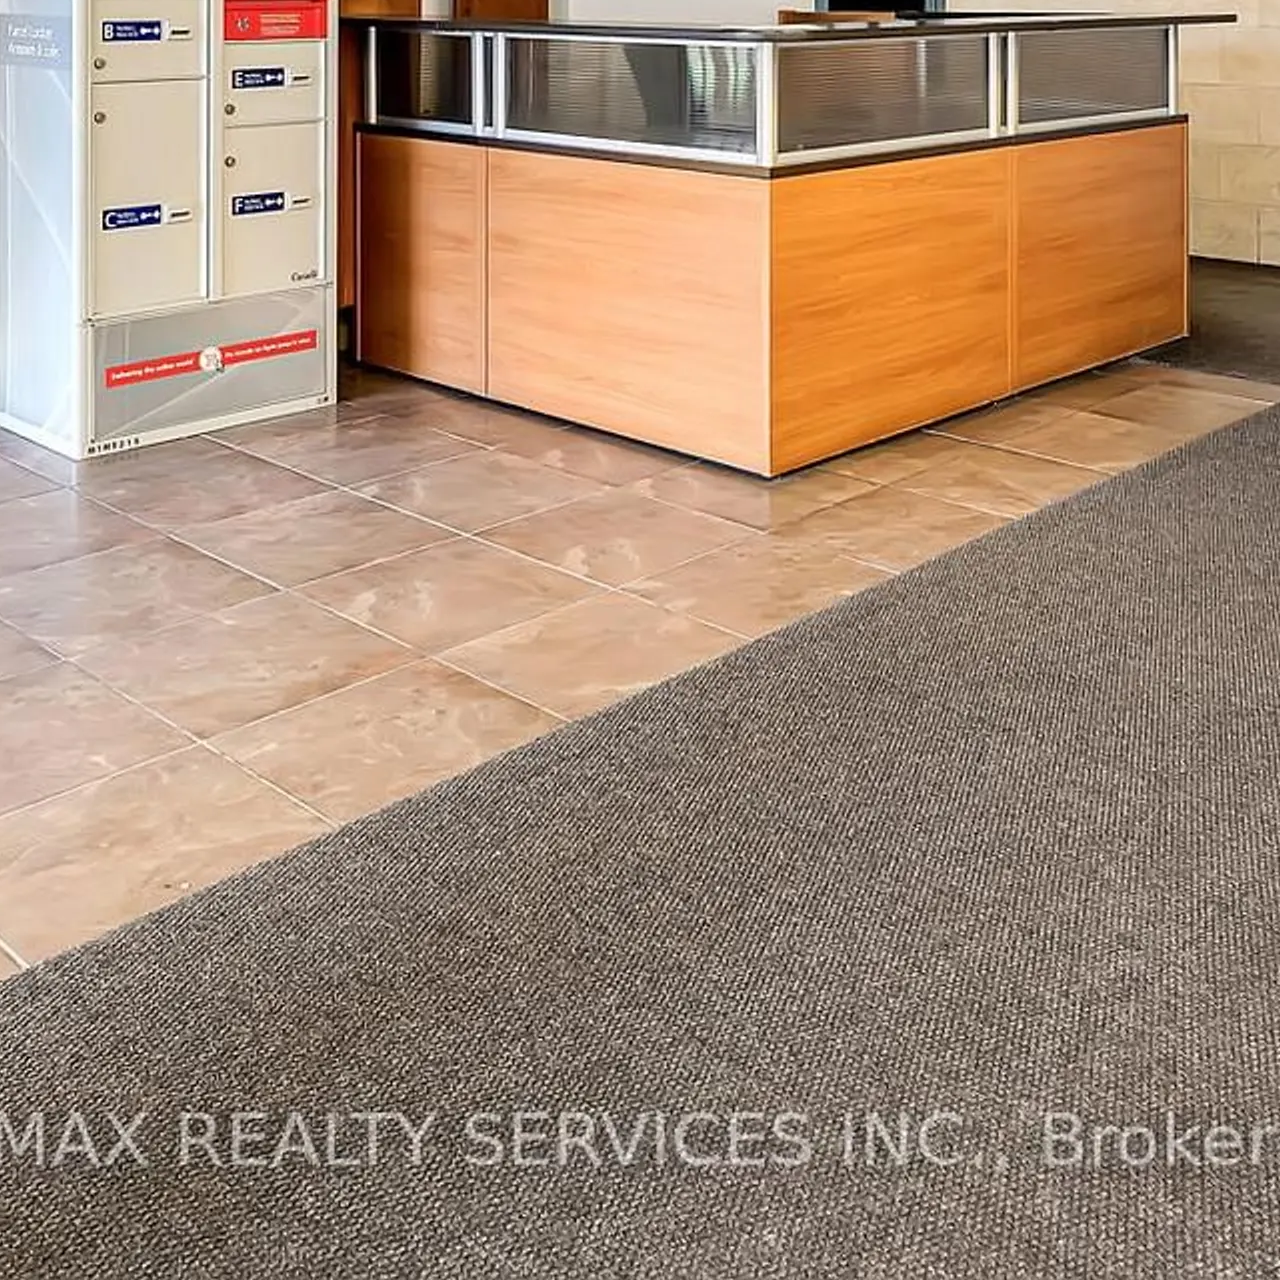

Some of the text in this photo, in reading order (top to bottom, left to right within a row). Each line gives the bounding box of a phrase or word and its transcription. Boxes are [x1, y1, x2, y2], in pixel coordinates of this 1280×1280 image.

[104, 24, 114, 39] B
[234, 72, 243, 87] E
[234, 197, 243, 213] F
[105, 212, 117, 227] C
